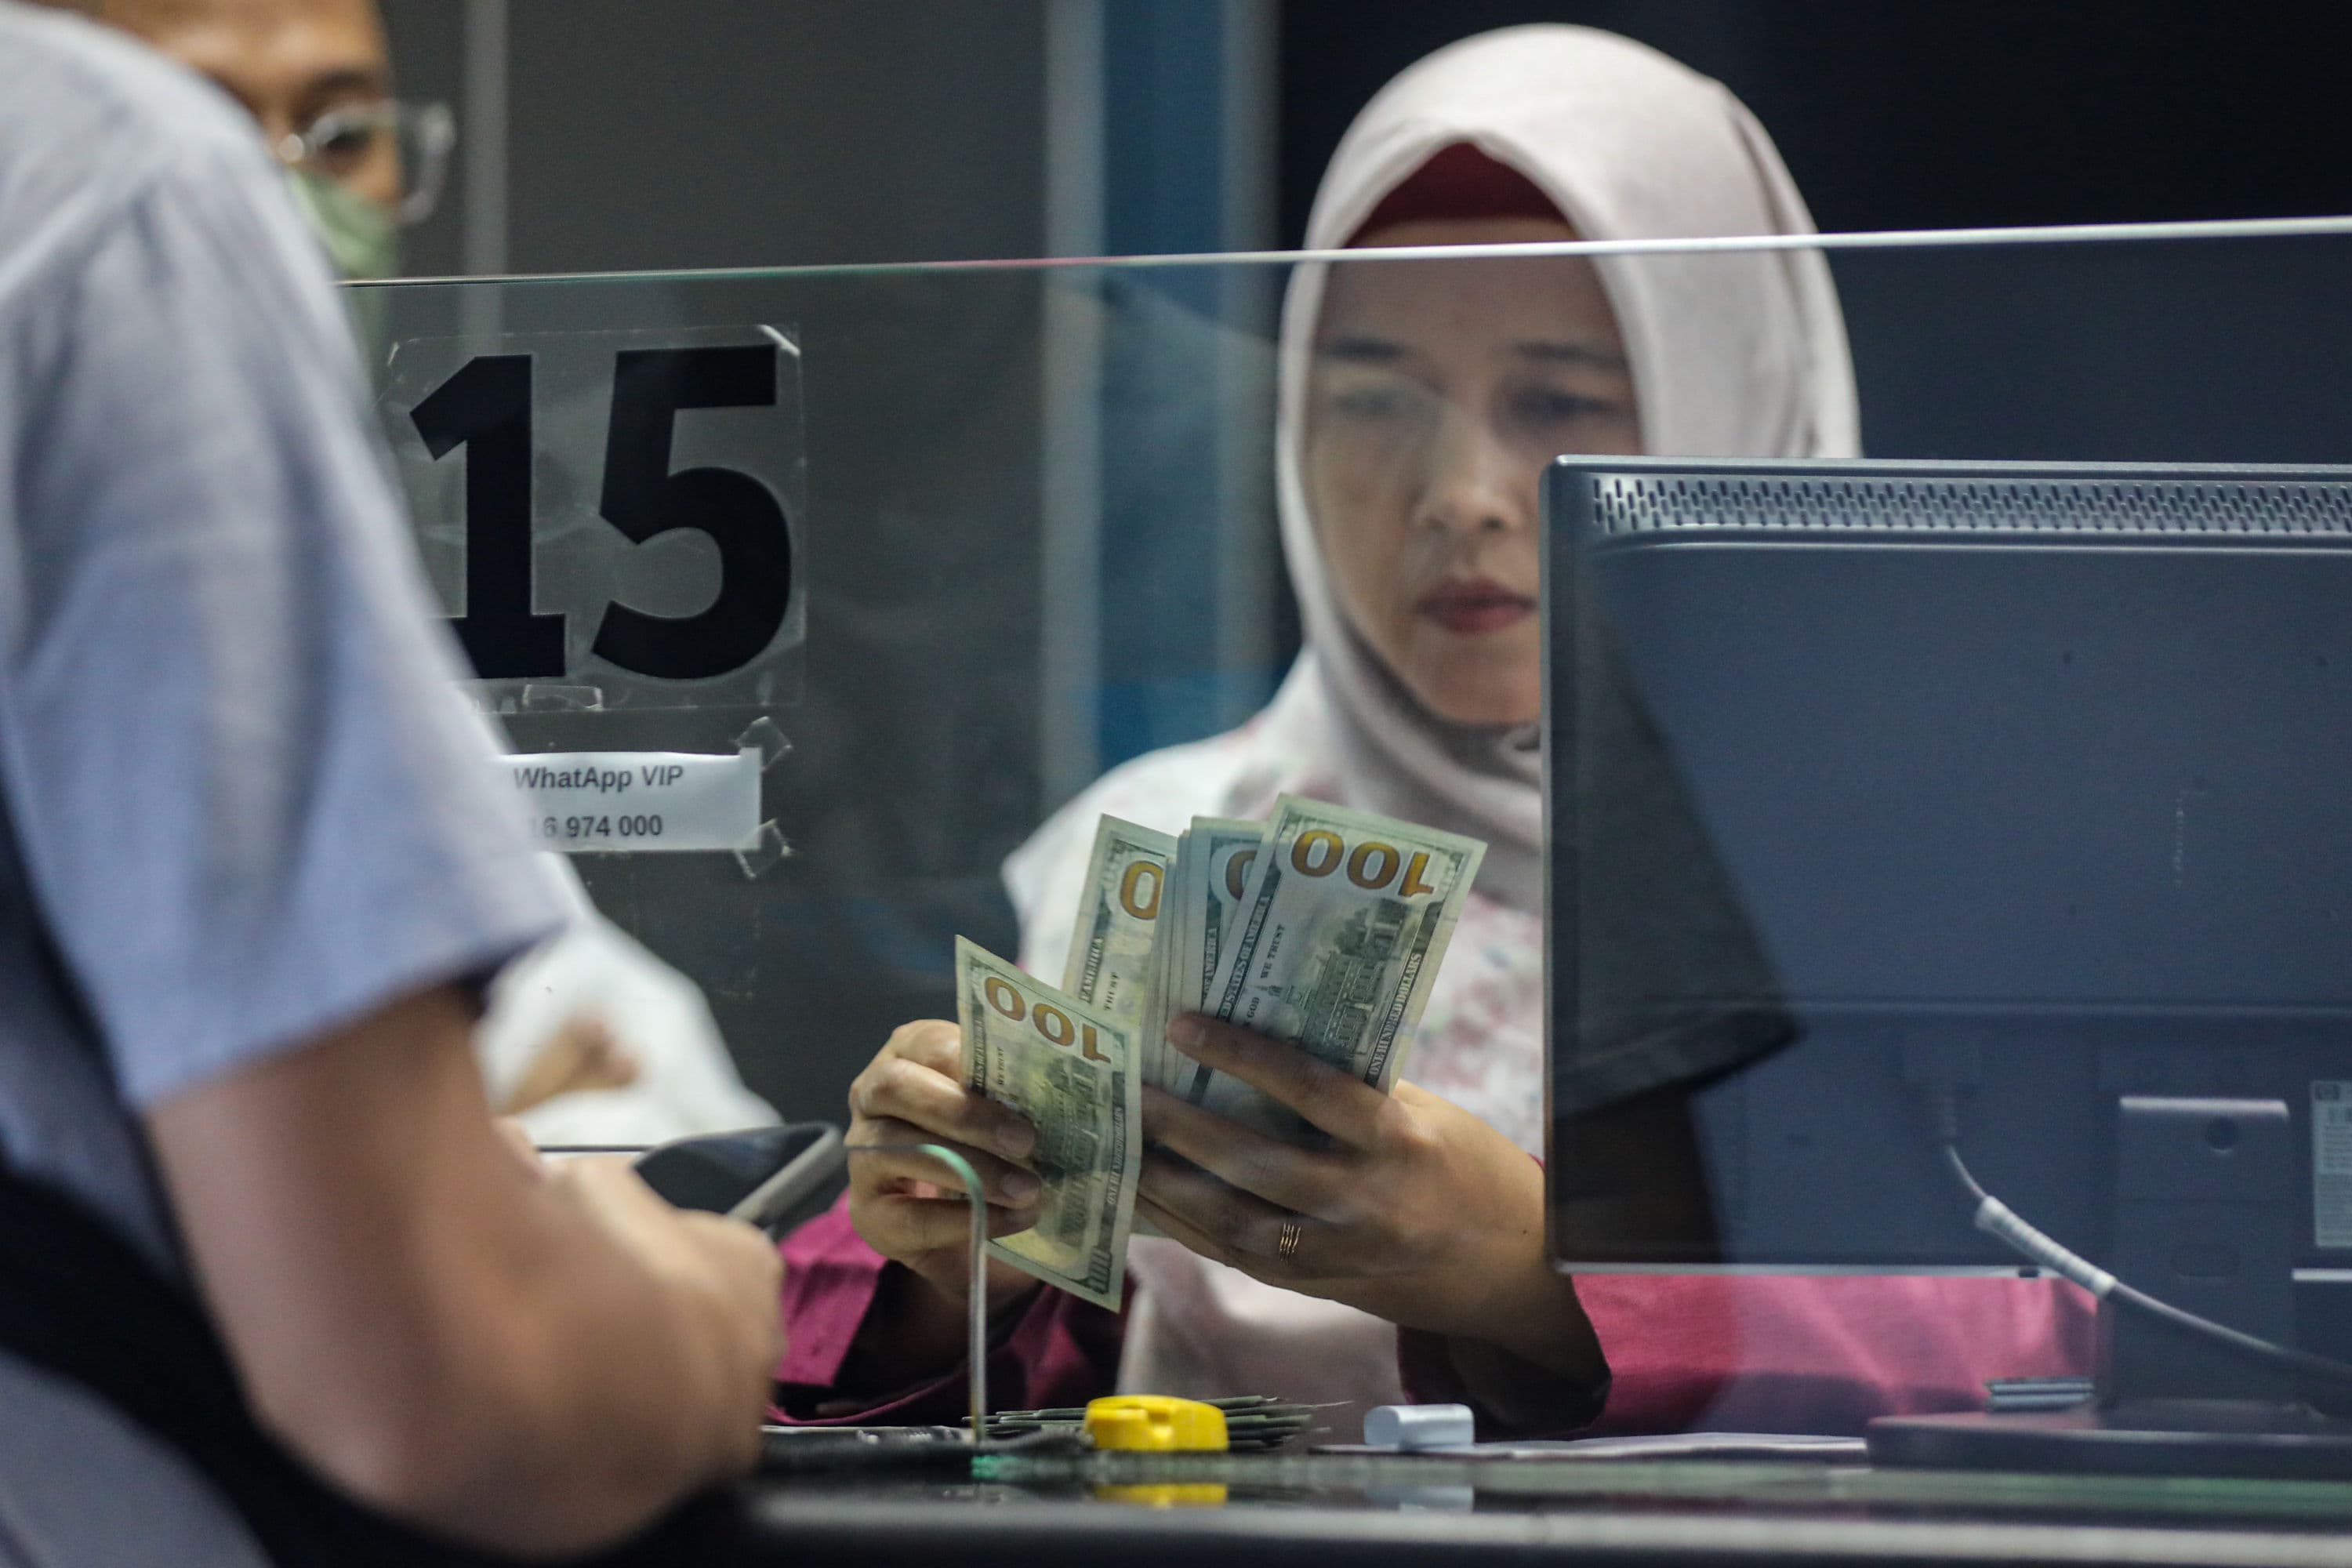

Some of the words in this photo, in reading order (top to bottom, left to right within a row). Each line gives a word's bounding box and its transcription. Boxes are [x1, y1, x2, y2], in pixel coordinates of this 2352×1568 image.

[409, 345, 790, 679] 15
[514, 766, 632, 793] WhatApp
[641, 764, 684, 786] VIP
[566, 816, 610, 837] 974
[619, 815, 662, 837] 000
[1290, 829, 1435, 898] 100
[1258, 961, 1272, 980] WE
[1265, 923, 1287, 960] TRUST
[1394, 950, 1422, 1004] DOLLARS
[985, 976, 1112, 1064] 100
[1245, 995, 1261, 1019] GOD
